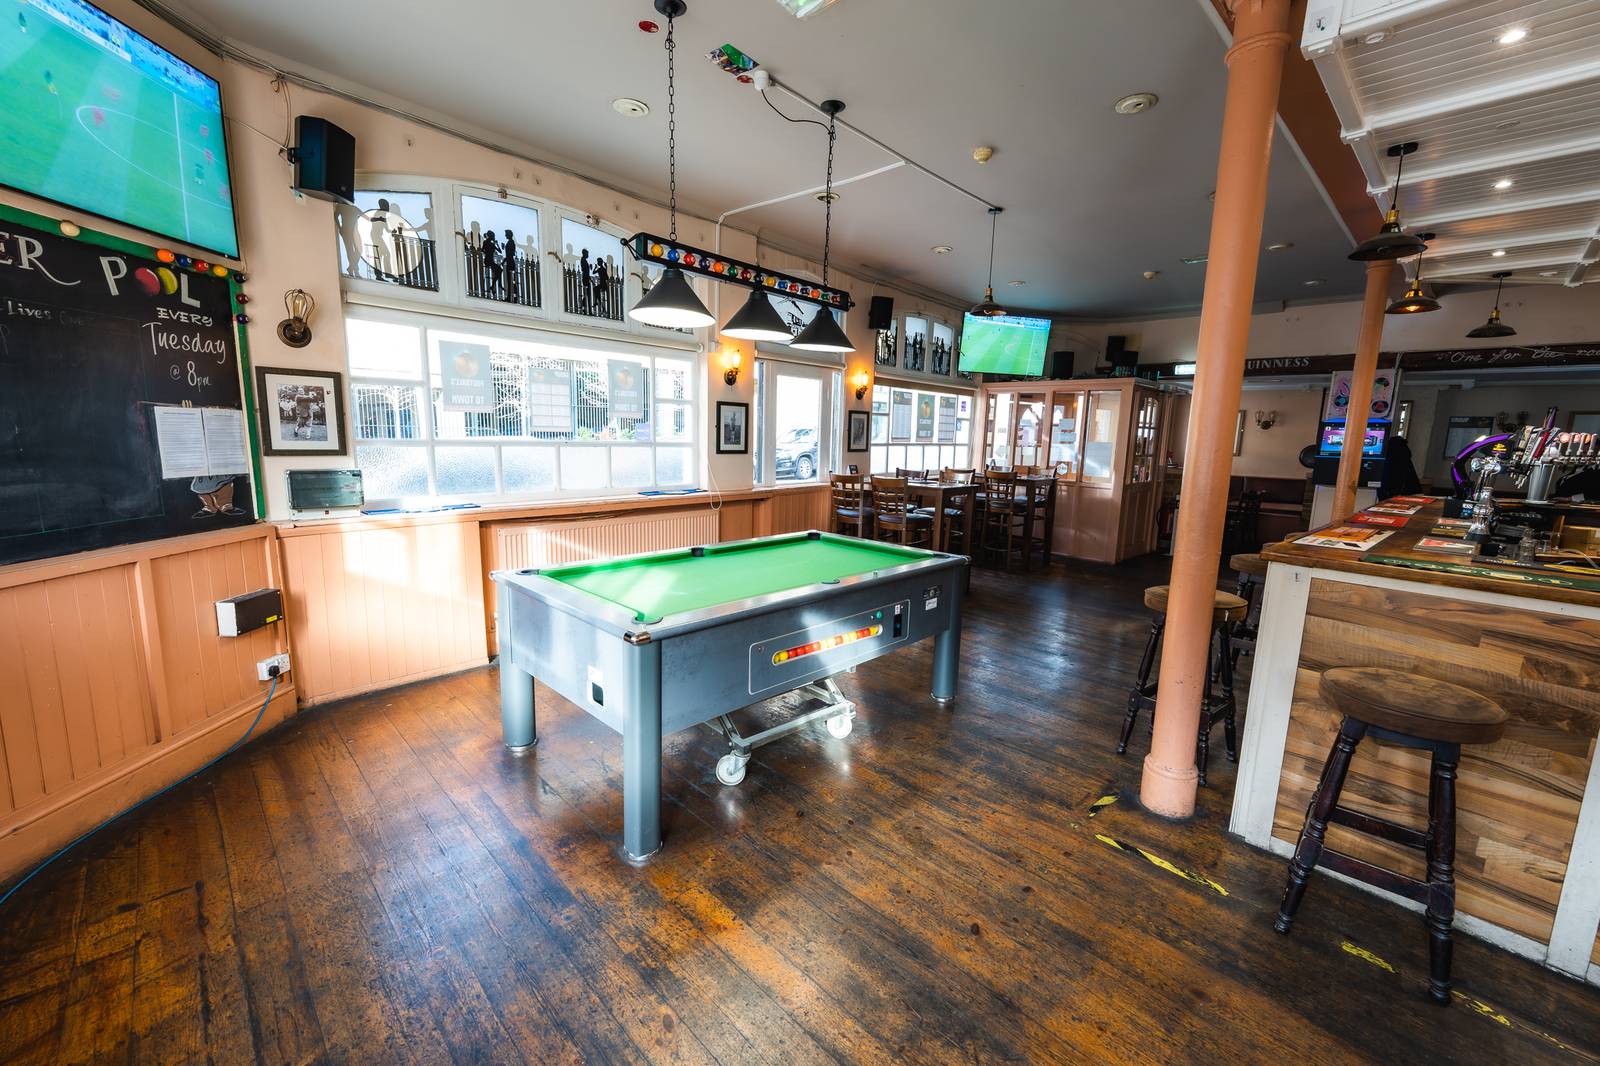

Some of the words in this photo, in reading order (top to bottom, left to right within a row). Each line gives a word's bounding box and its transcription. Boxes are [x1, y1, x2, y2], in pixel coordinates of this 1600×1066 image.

[7, 300, 52, 320] Lives
[142, 321, 226, 364] Tuesday
[1247, 357, 1311, 370] UINNESS
[1450, 351, 1483, 363] One
[1488, 349, 1521, 363] for
[170, 364, 182, 380] @
